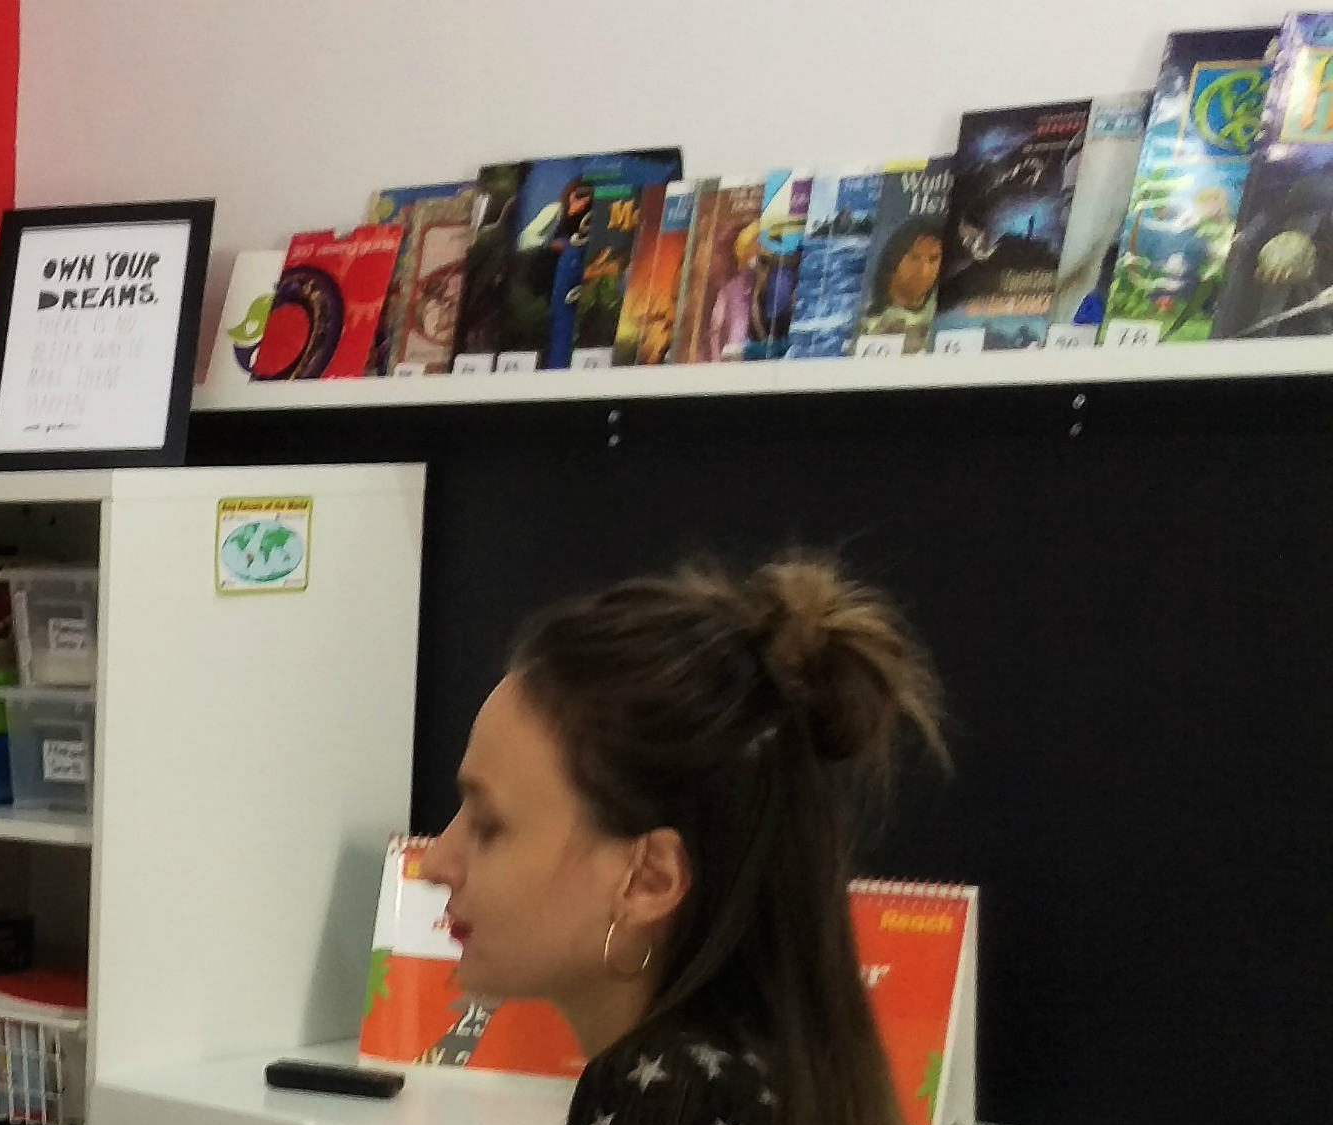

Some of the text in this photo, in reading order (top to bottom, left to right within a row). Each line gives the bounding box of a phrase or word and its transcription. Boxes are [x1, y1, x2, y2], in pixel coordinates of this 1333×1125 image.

[43, 251, 161, 284] OWN YOUR
[36, 283, 159, 312] DREAMS.
[879, 908, 954, 933] Reach
